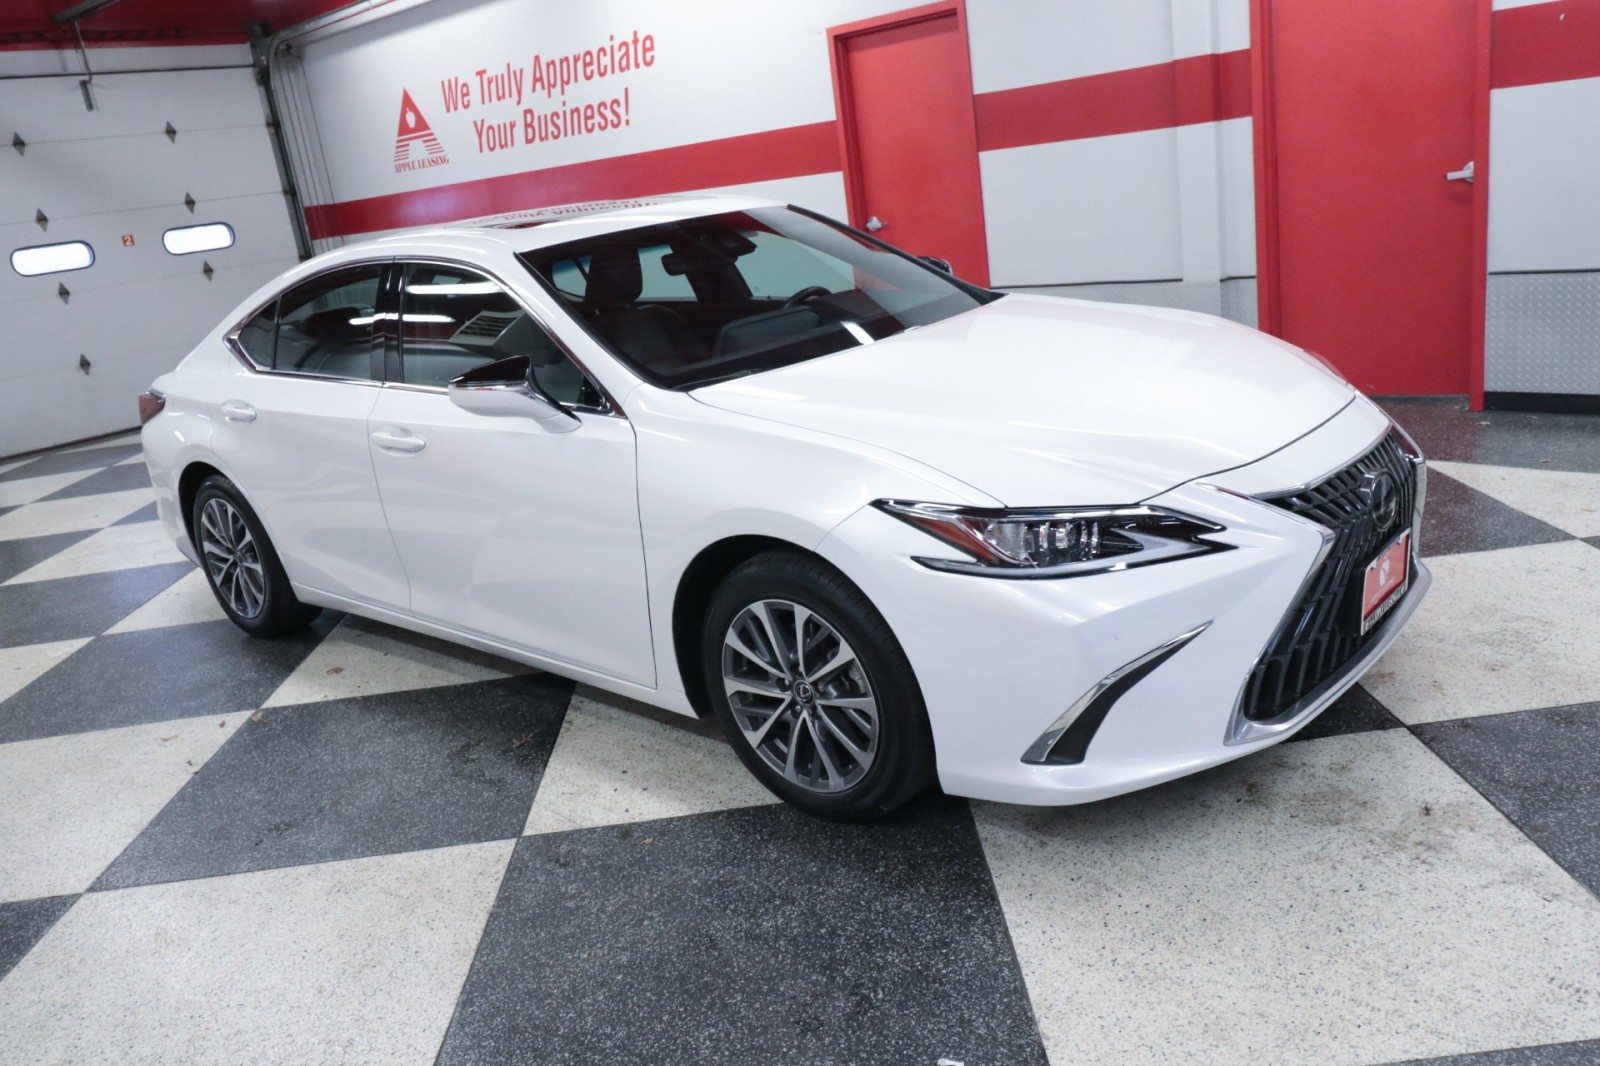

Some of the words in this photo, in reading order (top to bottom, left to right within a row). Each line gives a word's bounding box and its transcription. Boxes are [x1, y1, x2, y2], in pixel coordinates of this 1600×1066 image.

[441, 76, 471, 113] We
[475, 62, 524, 106] Truly
[531, 30, 655, 99] Appreciate
[473, 118, 516, 153] Your
[523, 87, 630, 144] Business!
[394, 160, 417, 174] APPLE
[417, 155, 450, 170] LEASING
[123, 235, 134, 246] 2
